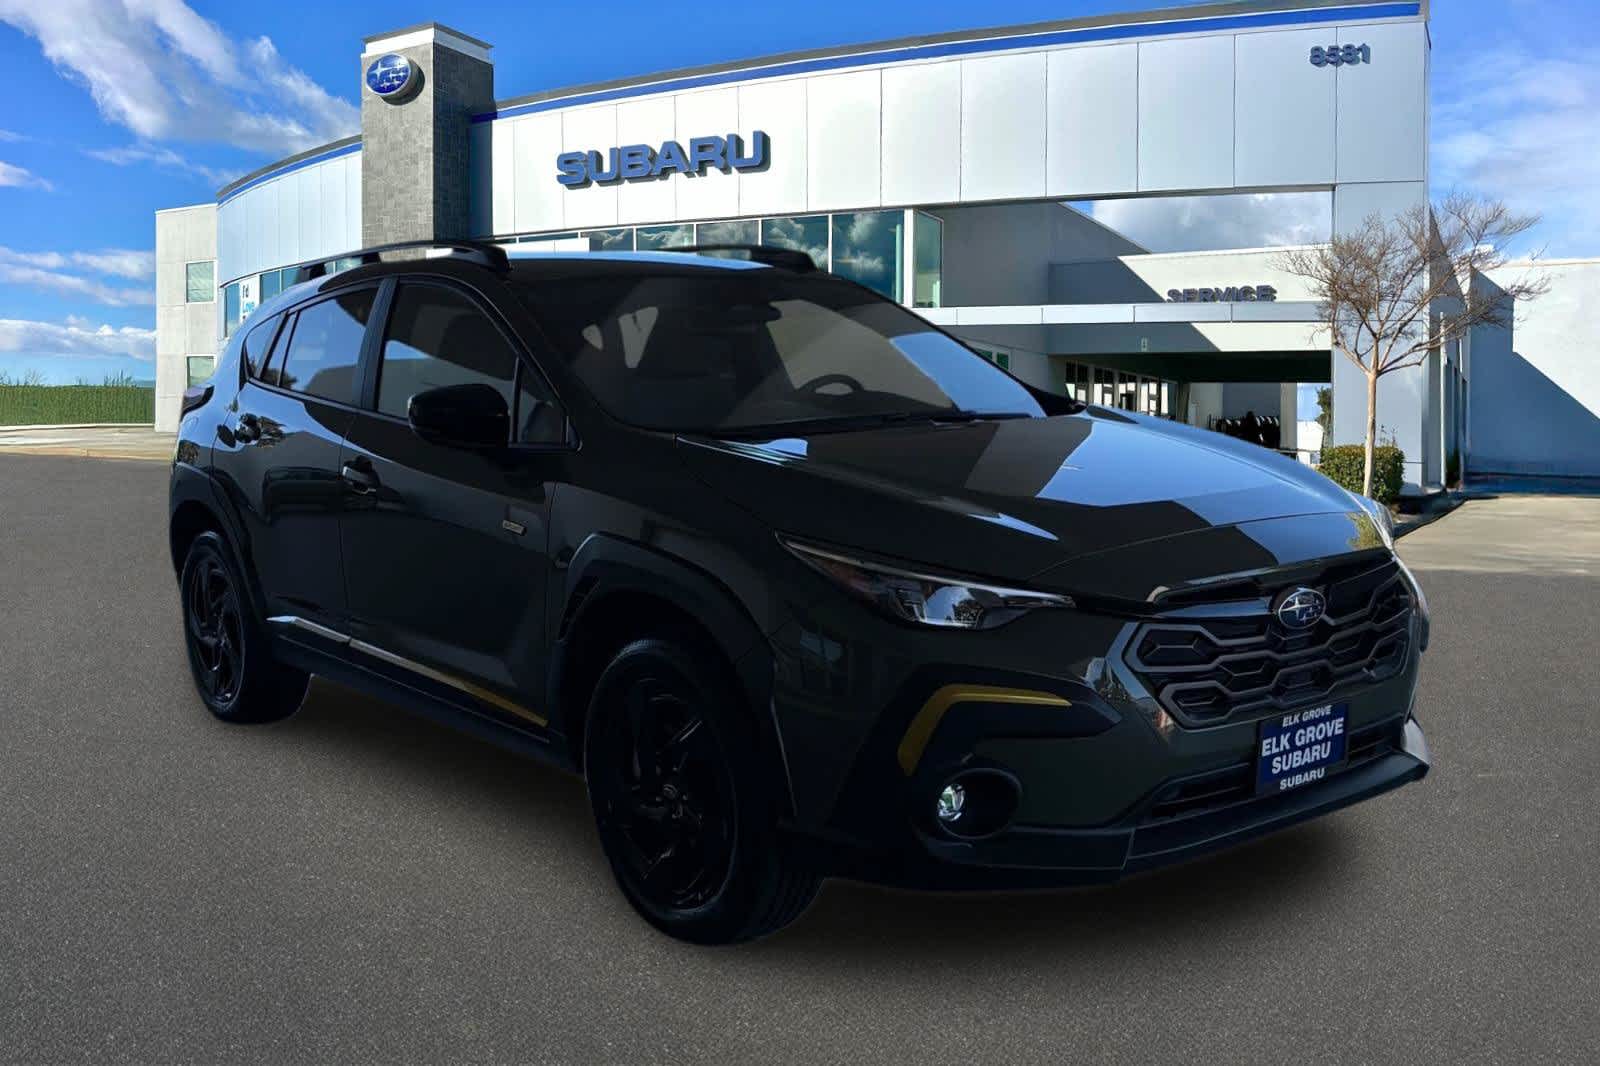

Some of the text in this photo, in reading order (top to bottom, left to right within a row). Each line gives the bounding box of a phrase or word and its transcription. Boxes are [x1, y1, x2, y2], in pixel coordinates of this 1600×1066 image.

[556, 130, 770, 190] SUBARU
[1166, 285, 1277, 303] SERVICE
[1282, 704, 1333, 728] ELK GROVE
[1261, 717, 1344, 757] ELK GROVE
[1271, 741, 1332, 775] SUBARU
[1279, 767, 1326, 791] SUBARU
